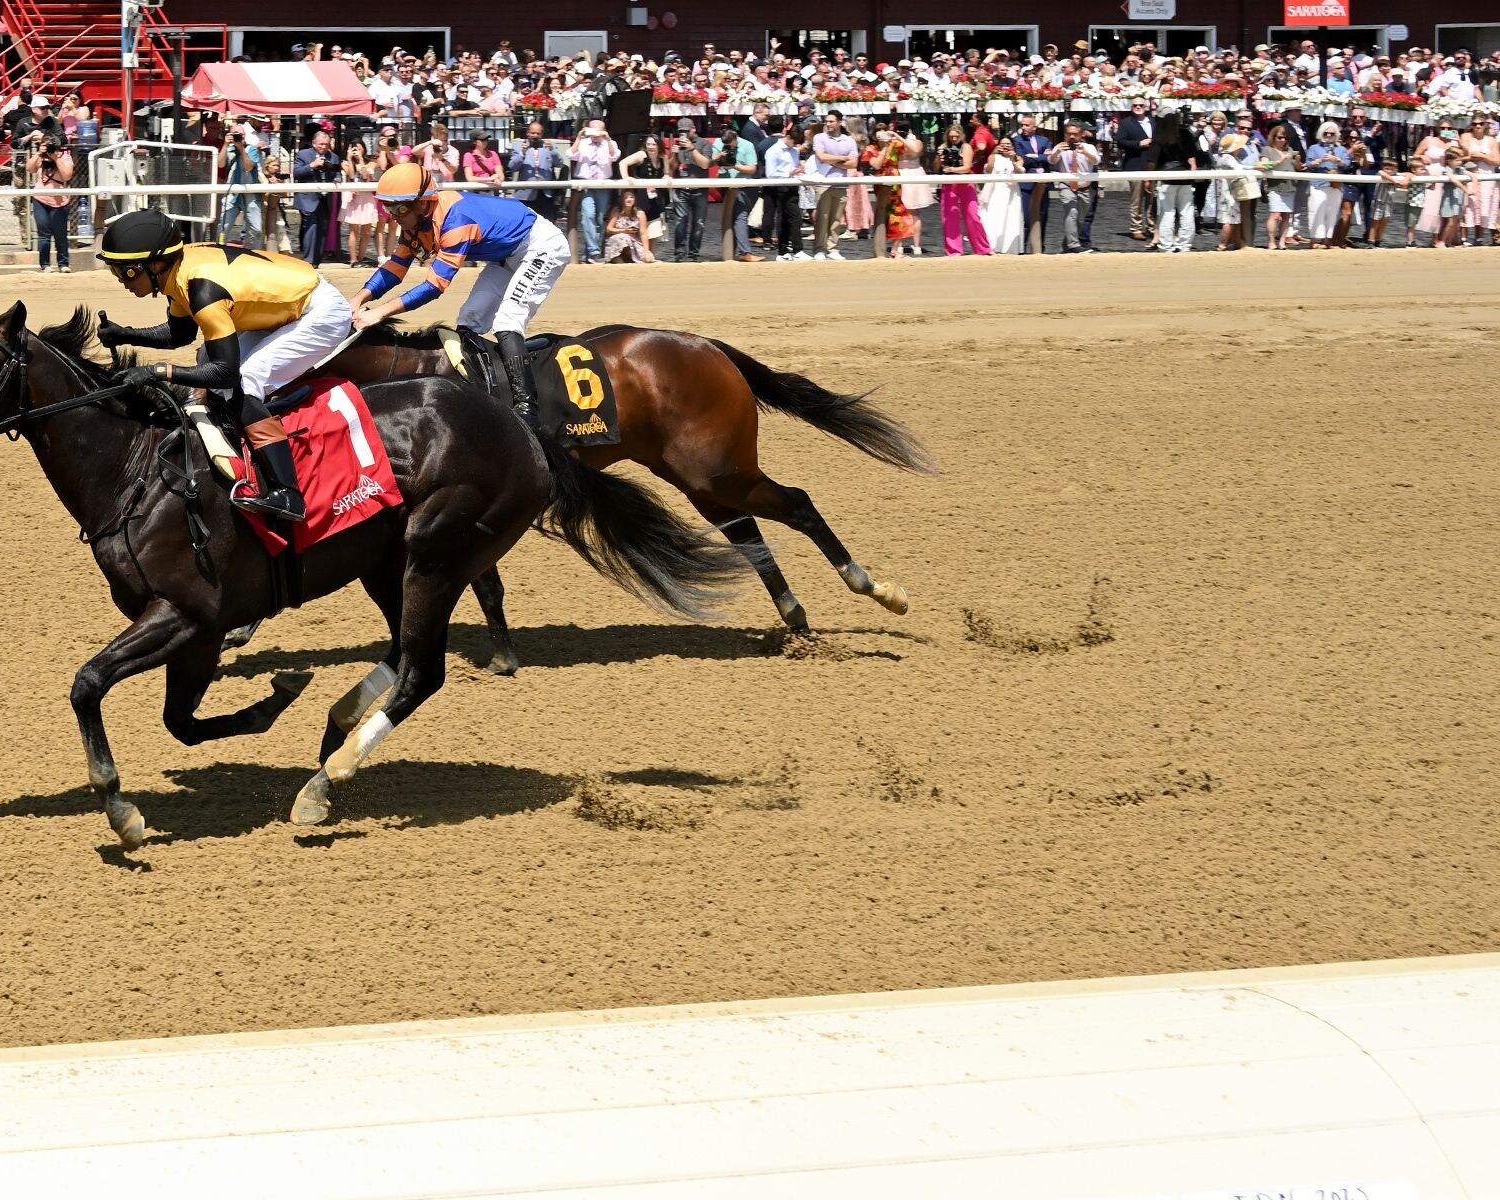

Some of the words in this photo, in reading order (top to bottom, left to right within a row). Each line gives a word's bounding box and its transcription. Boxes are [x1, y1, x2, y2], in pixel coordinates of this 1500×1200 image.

[1287, 5, 1347, 17] SARATOGA
[510, 280, 528, 305] JEFF
[555, 344, 604, 410] 6
[327, 385, 375, 468] 1
[565, 421, 608, 436] SARATOGA
[332, 481, 387, 516] SARATOGA
